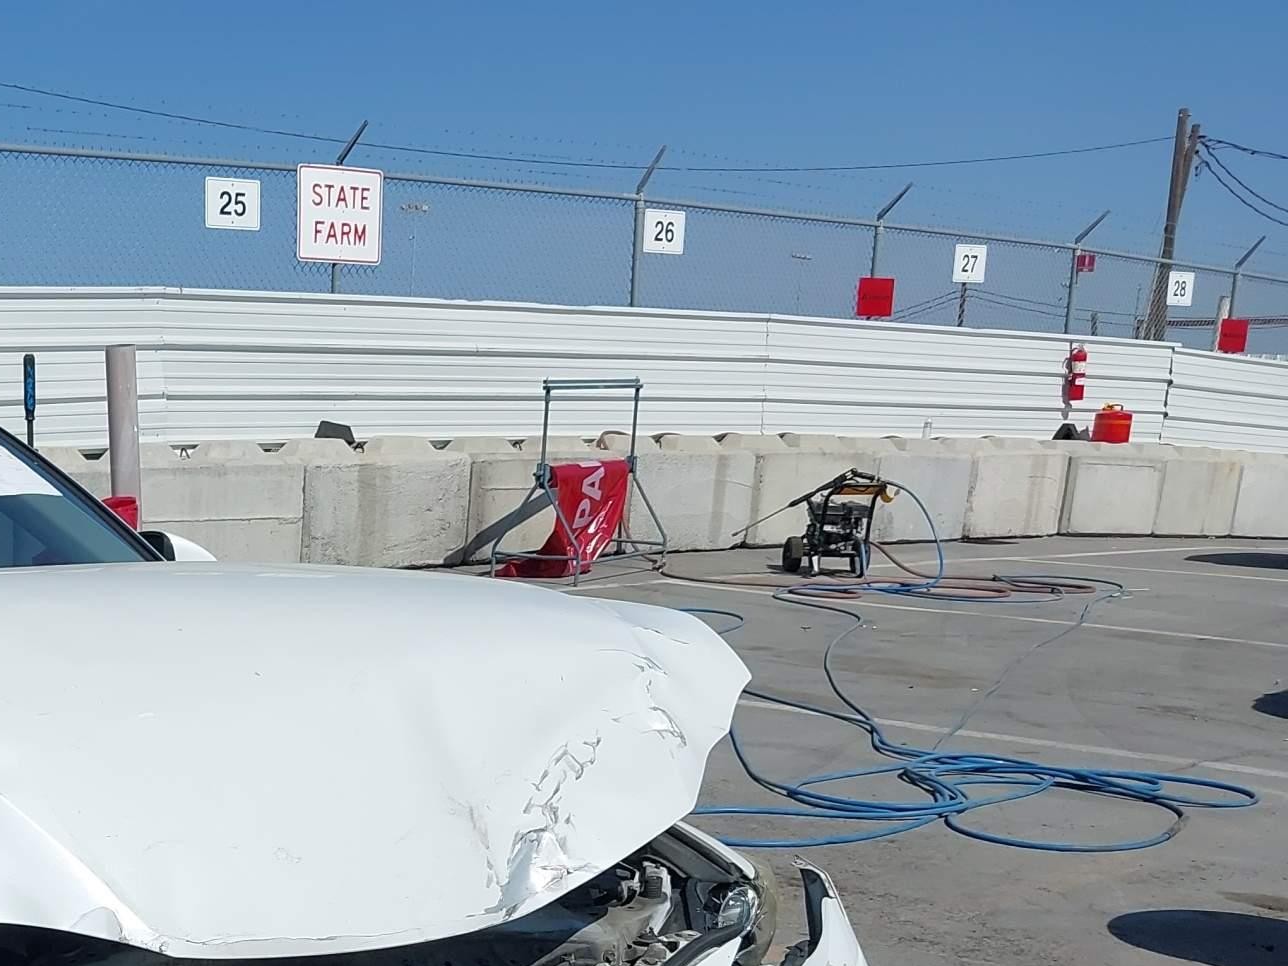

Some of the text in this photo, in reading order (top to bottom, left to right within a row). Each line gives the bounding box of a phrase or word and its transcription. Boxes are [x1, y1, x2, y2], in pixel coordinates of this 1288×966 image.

[219, 190, 247, 217] 25
[311, 183, 371, 210] STATE
[313, 220, 367, 247] FARM
[654, 220, 675, 243] 26
[961, 254, 978, 273] 27
[1173, 279, 1187, 298] 28
[572, 461, 605, 529] PA
